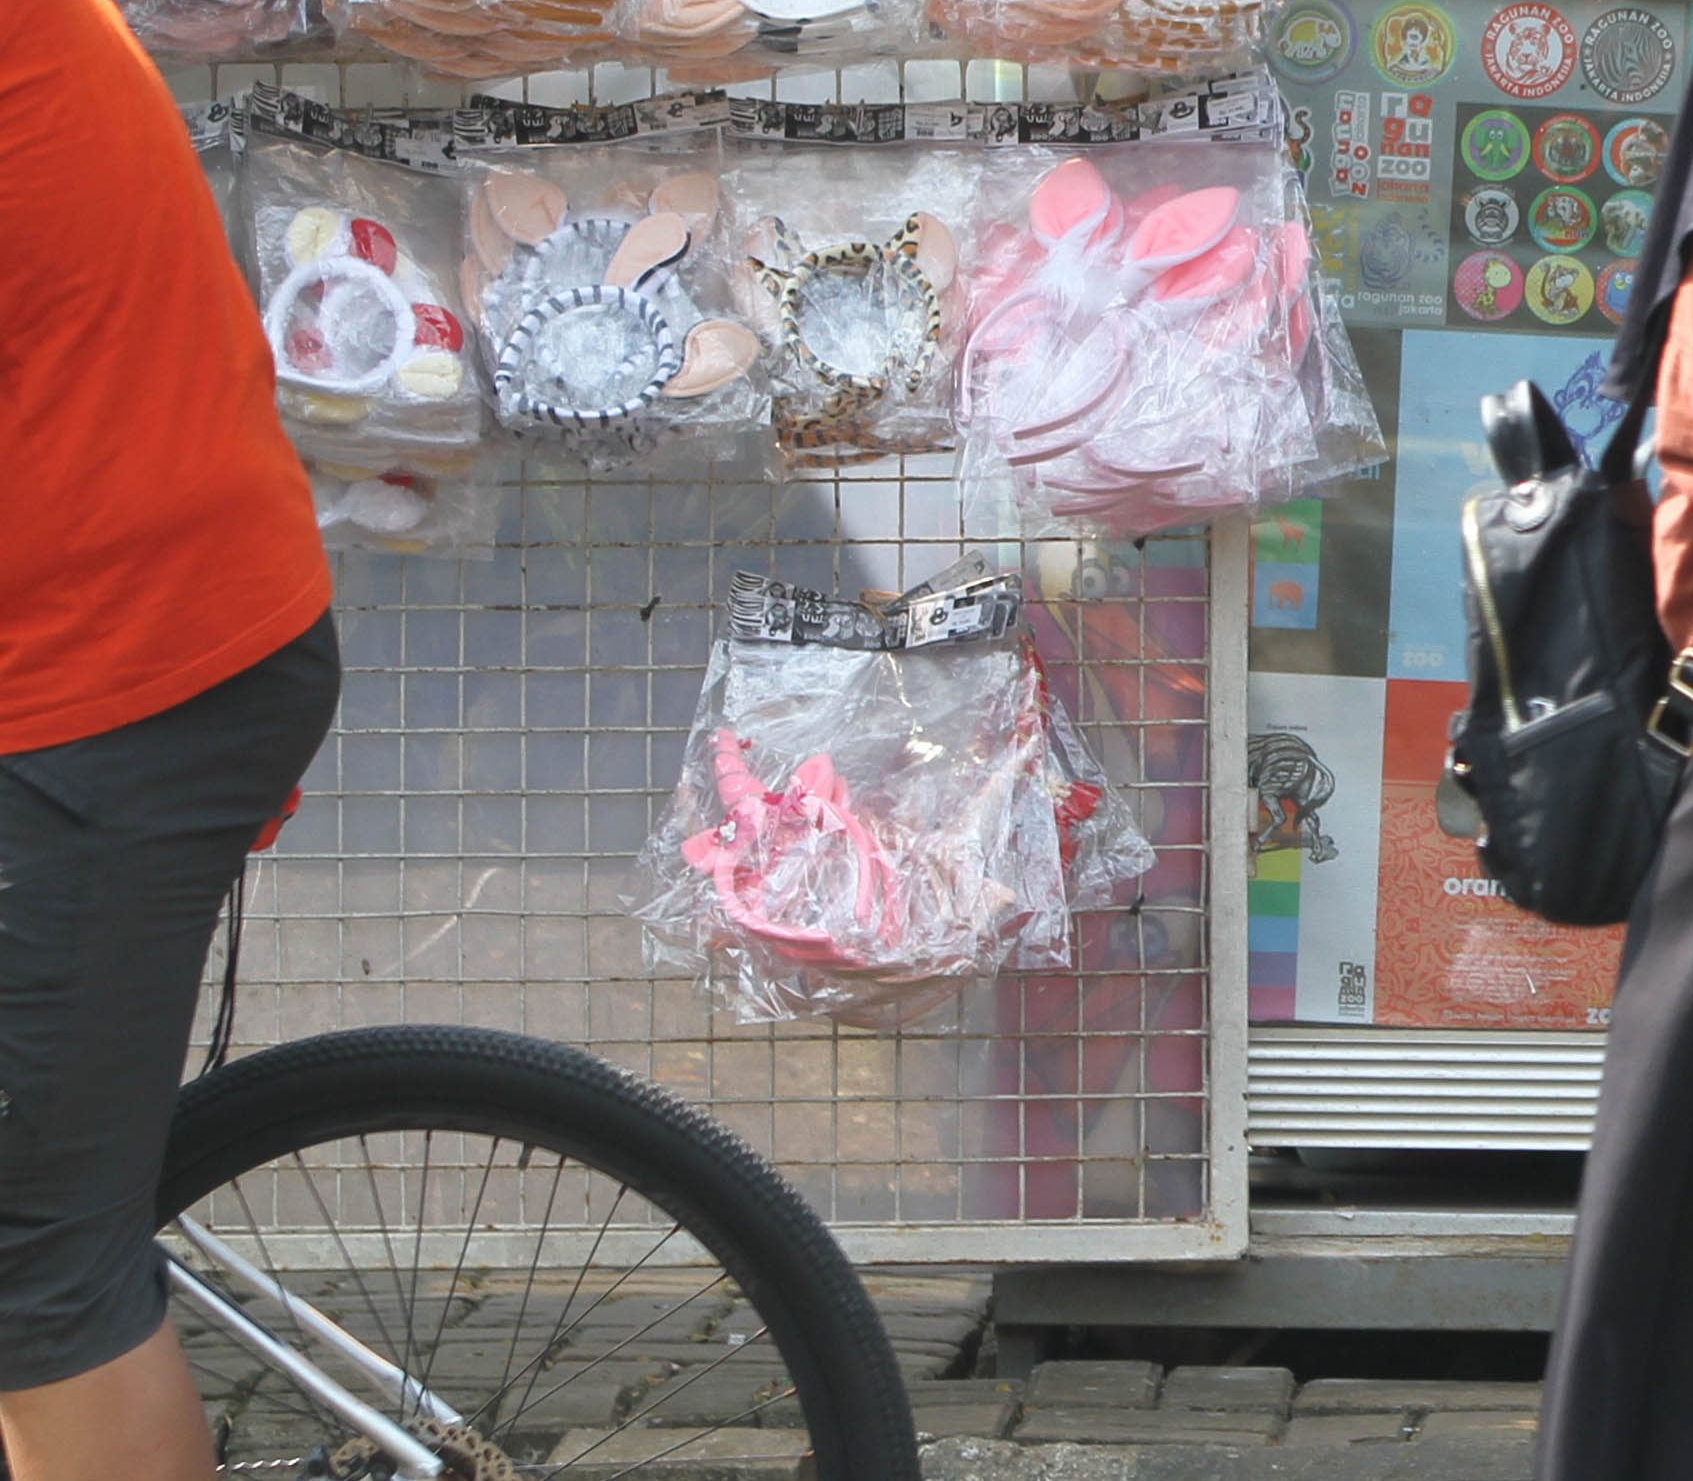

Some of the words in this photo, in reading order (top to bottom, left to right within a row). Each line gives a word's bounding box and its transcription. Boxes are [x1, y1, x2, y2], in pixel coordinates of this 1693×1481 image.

[1486, 5, 1551, 41] RAGUNAN
[1552, 16, 1575, 46] ZOO
[1585, 10, 1650, 47] RAGUNAN
[1650, 20, 1674, 51] ZOO
[1484, 53, 1520, 96] JAKARTA
[1583, 58, 1619, 101] JAKARTA
[1377, 155, 1430, 180] zoo
[1357, 291, 1415, 305] ragunan
[1417, 293, 1443, 305] zoo
[1398, 304, 1443, 316] jakarta
